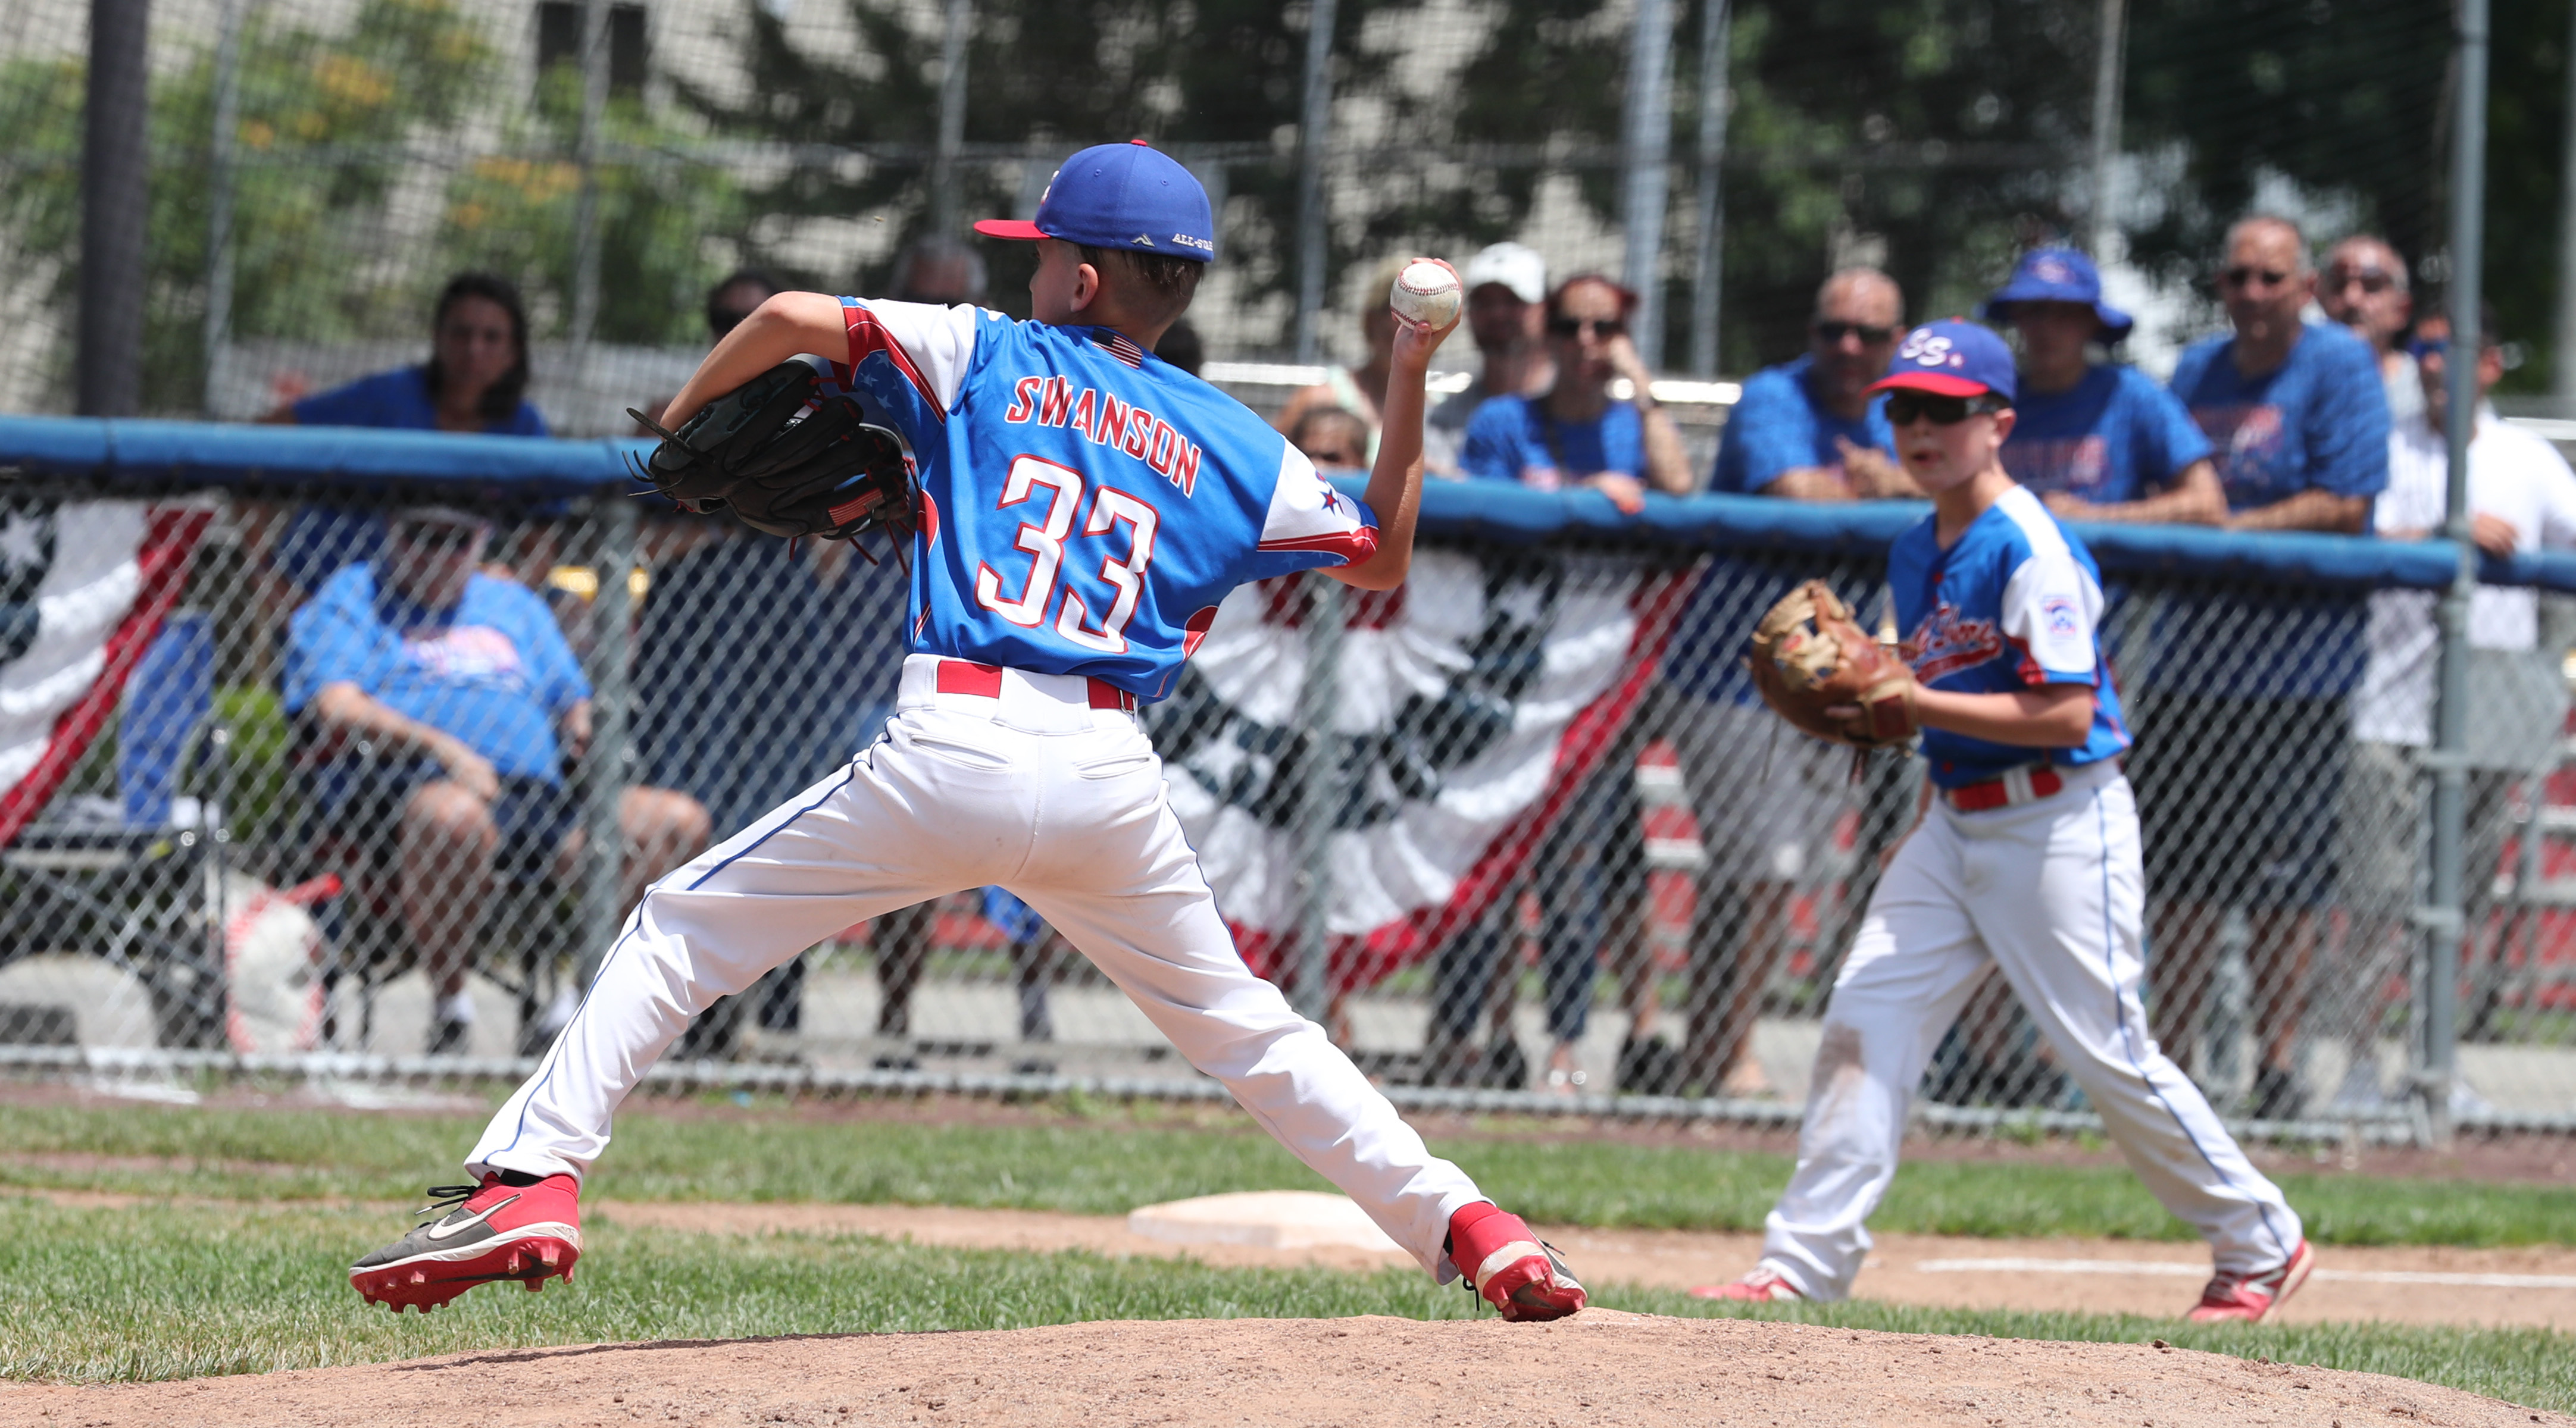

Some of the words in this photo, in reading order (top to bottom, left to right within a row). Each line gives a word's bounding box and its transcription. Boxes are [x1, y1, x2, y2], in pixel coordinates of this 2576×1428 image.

[1901, 327, 1953, 367] SS
[1004, 374, 1202, 499] SWANSON
[974, 453, 1160, 654] 33
